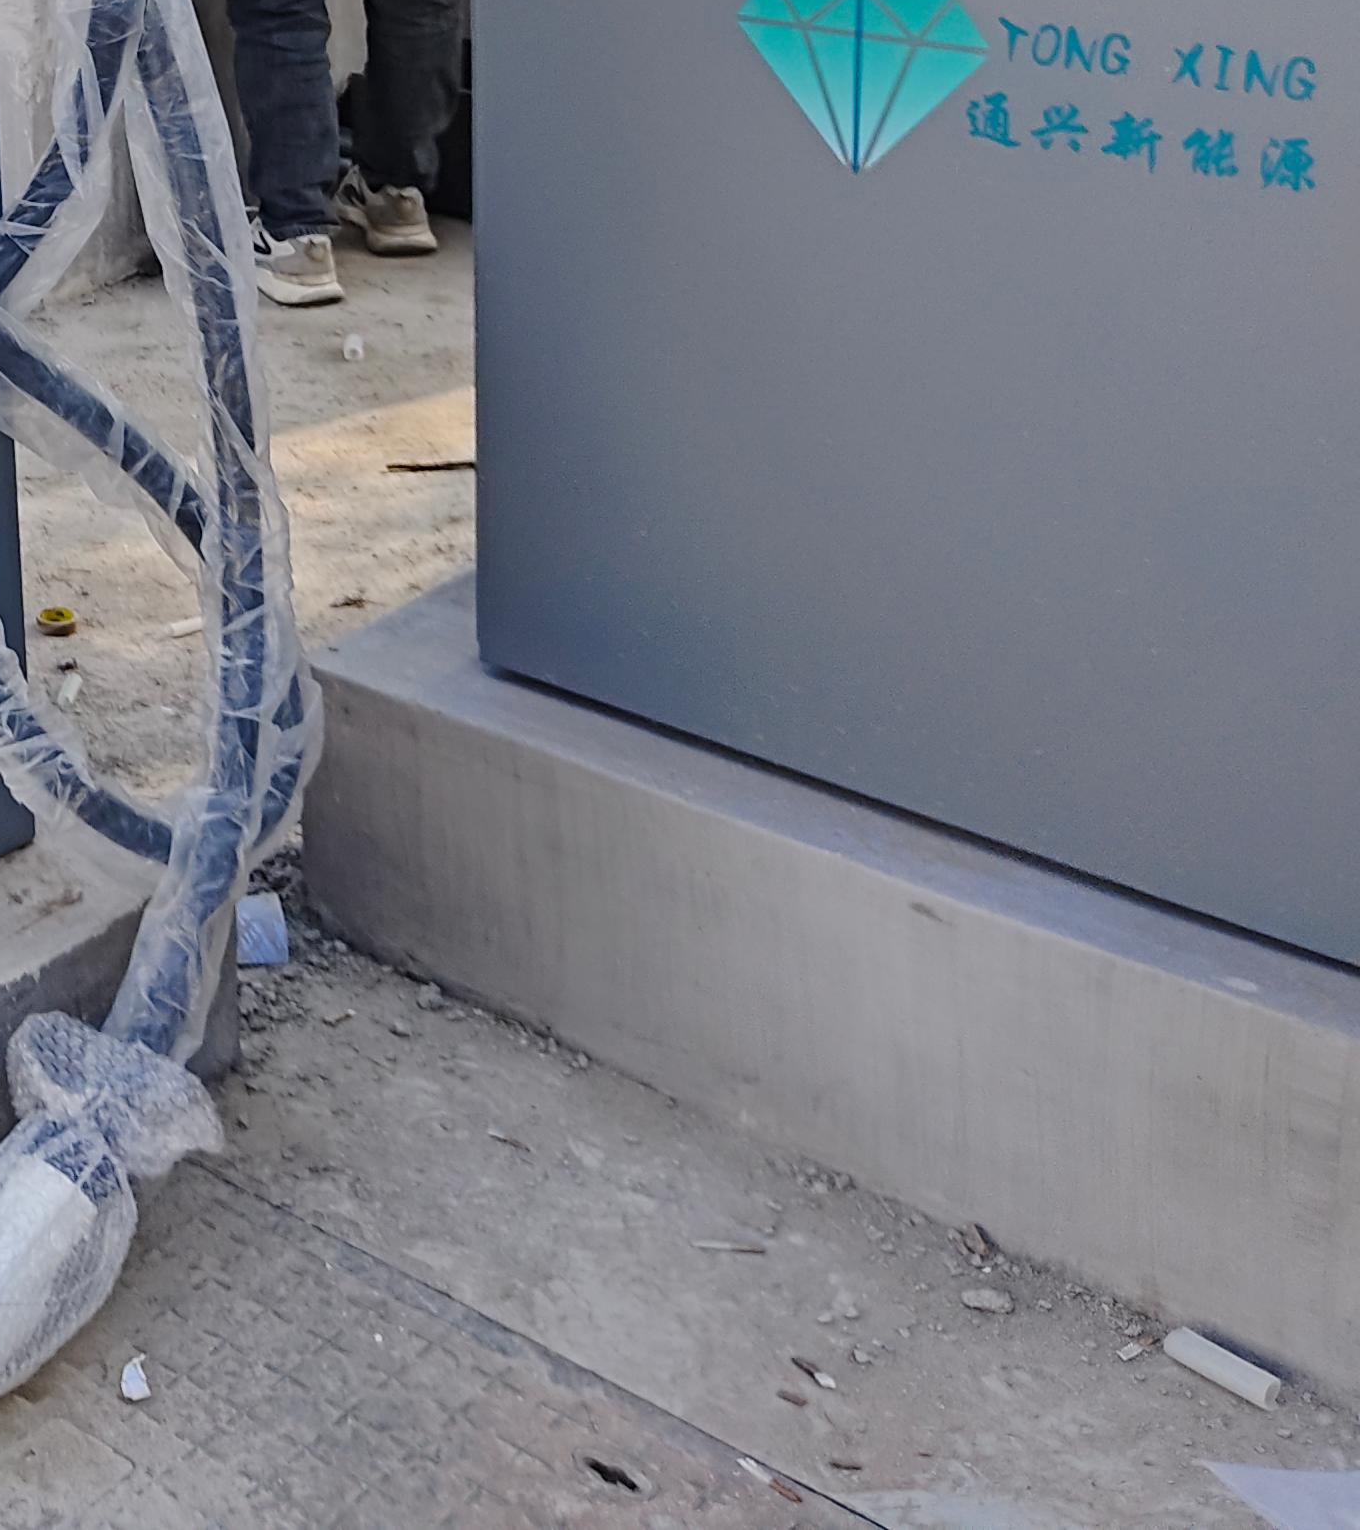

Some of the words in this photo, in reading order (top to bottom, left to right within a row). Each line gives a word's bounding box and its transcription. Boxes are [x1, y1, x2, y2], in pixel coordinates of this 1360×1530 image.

[998, 17, 1131, 75] TONG
[1172, 42, 1316, 101] XING
[966, 91, 1315, 192] 通兴新能源
